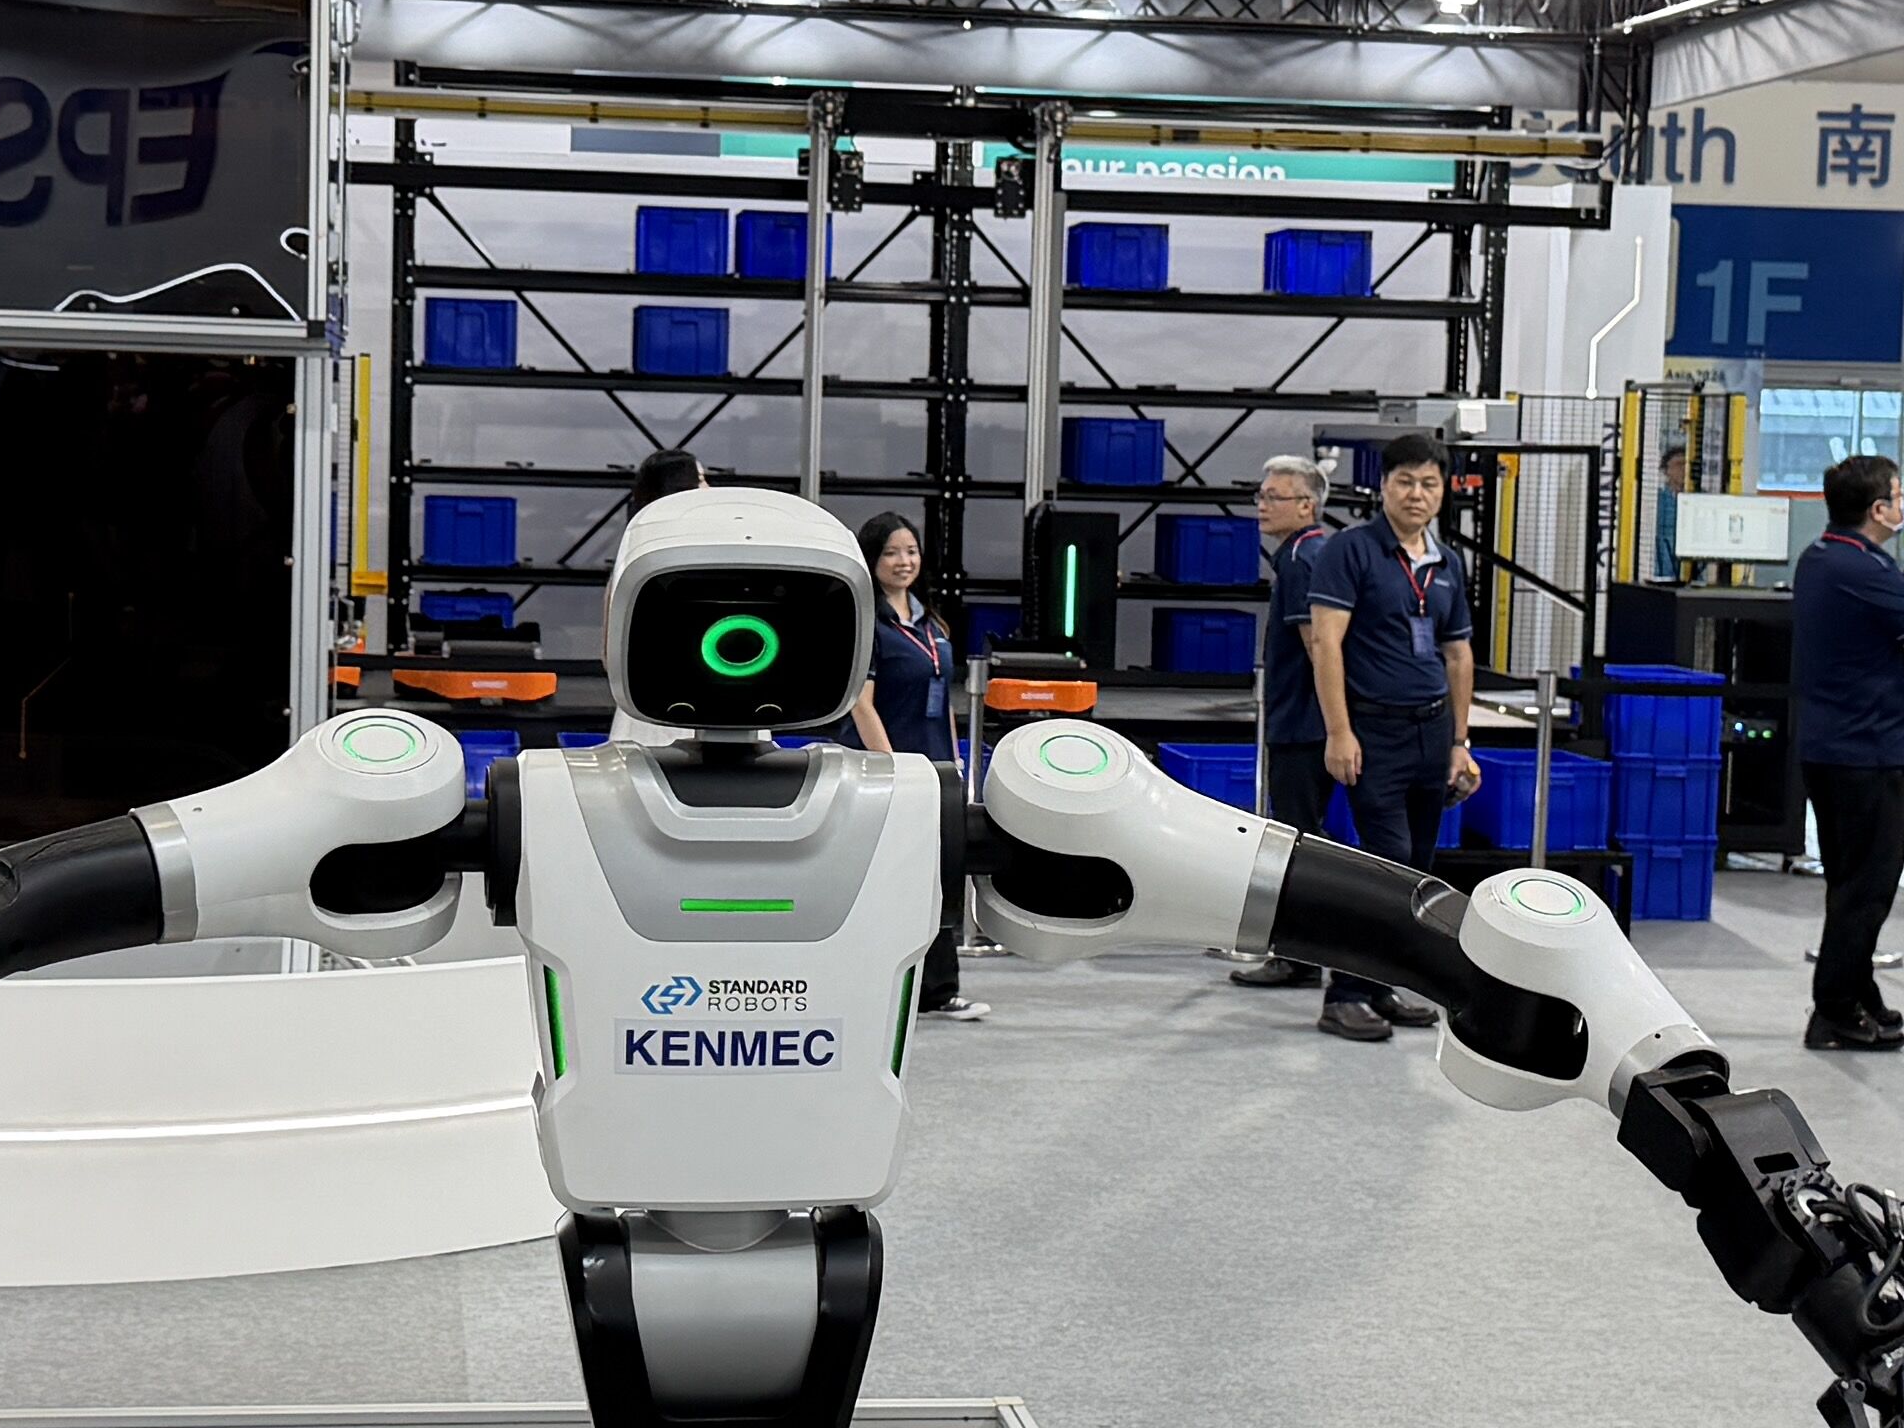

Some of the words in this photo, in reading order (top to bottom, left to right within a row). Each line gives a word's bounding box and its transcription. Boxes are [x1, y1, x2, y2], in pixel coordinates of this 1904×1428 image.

[1817, 103, 1895, 188] 南
[1696, 259, 1809, 346] 1F
[707, 997, 807, 1011] ROBOTS
[708, 980, 808, 994] STANDARD
[625, 1029, 835, 1066] KENMEC
